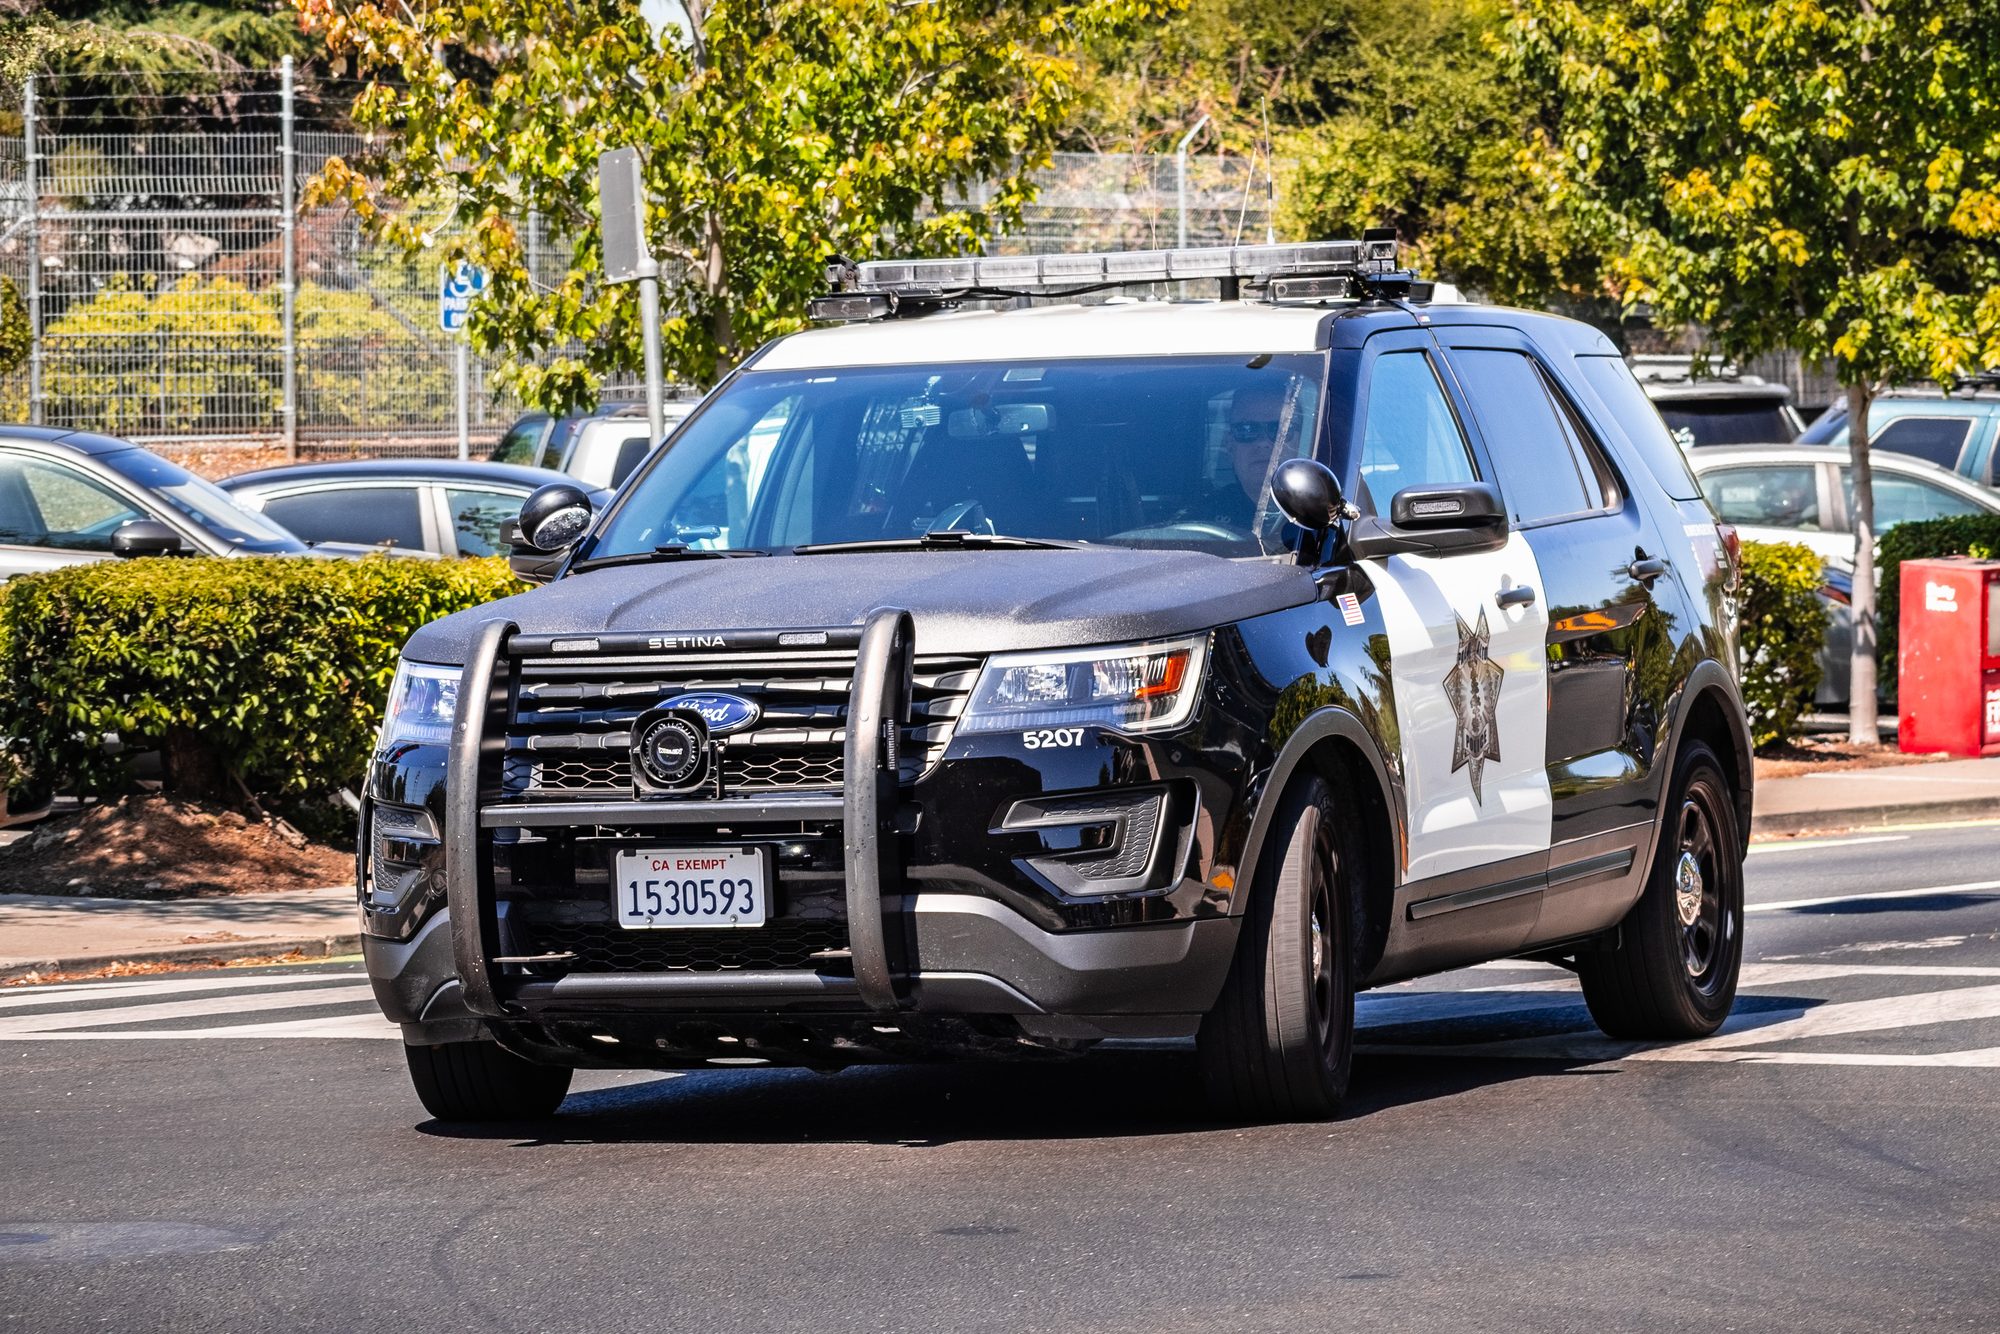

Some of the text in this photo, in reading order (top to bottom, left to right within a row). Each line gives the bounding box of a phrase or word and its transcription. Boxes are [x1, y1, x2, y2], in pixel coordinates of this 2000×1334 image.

[648, 635, 726, 649] SETINA
[1023, 728, 1085, 750] 5207
[652, 859, 727, 872] CA EXEMPT
[628, 878, 754, 917] 1530593
